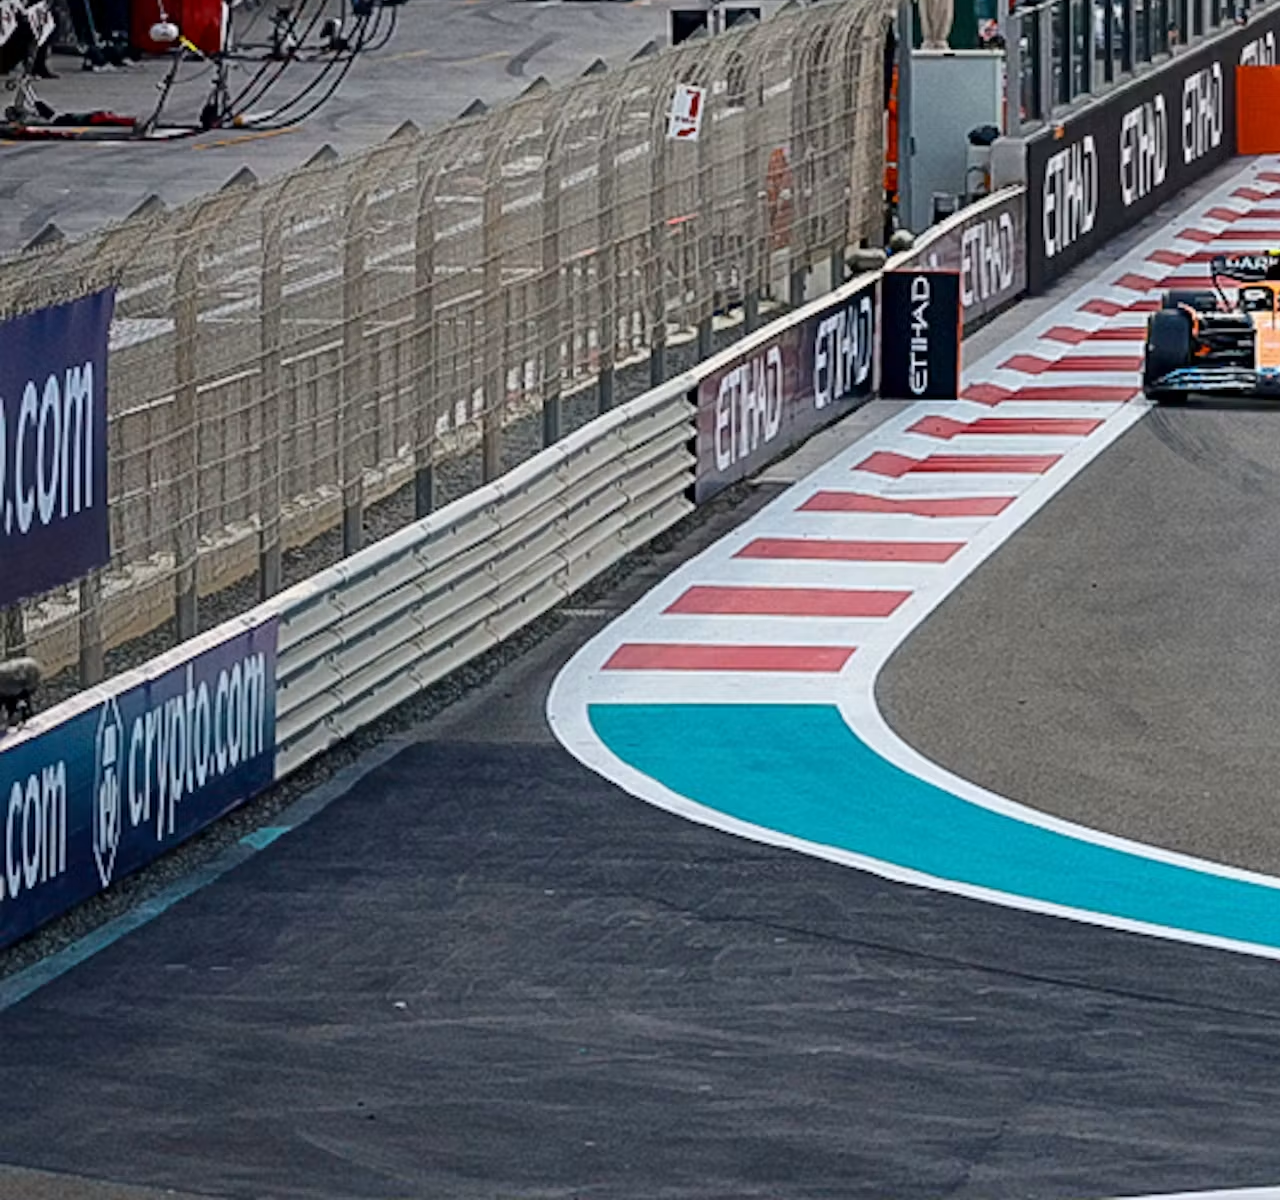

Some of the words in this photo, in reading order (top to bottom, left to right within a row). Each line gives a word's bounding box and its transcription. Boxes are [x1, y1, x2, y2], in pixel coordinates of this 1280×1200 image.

[1119, 93, 1169, 207] ETIHAD
[1181, 61, 1225, 165] ETIHAD
[1043, 135, 1099, 258] ETIHAD
[961, 212, 1015, 307] ETIHAD
[813, 295, 873, 410] ETIHAD
[909, 274, 931, 396] ETIHAD
[0, 361, 94, 536] .com
[714, 345, 783, 472] ETIHAD
[128, 652, 266, 842] crypto.com
